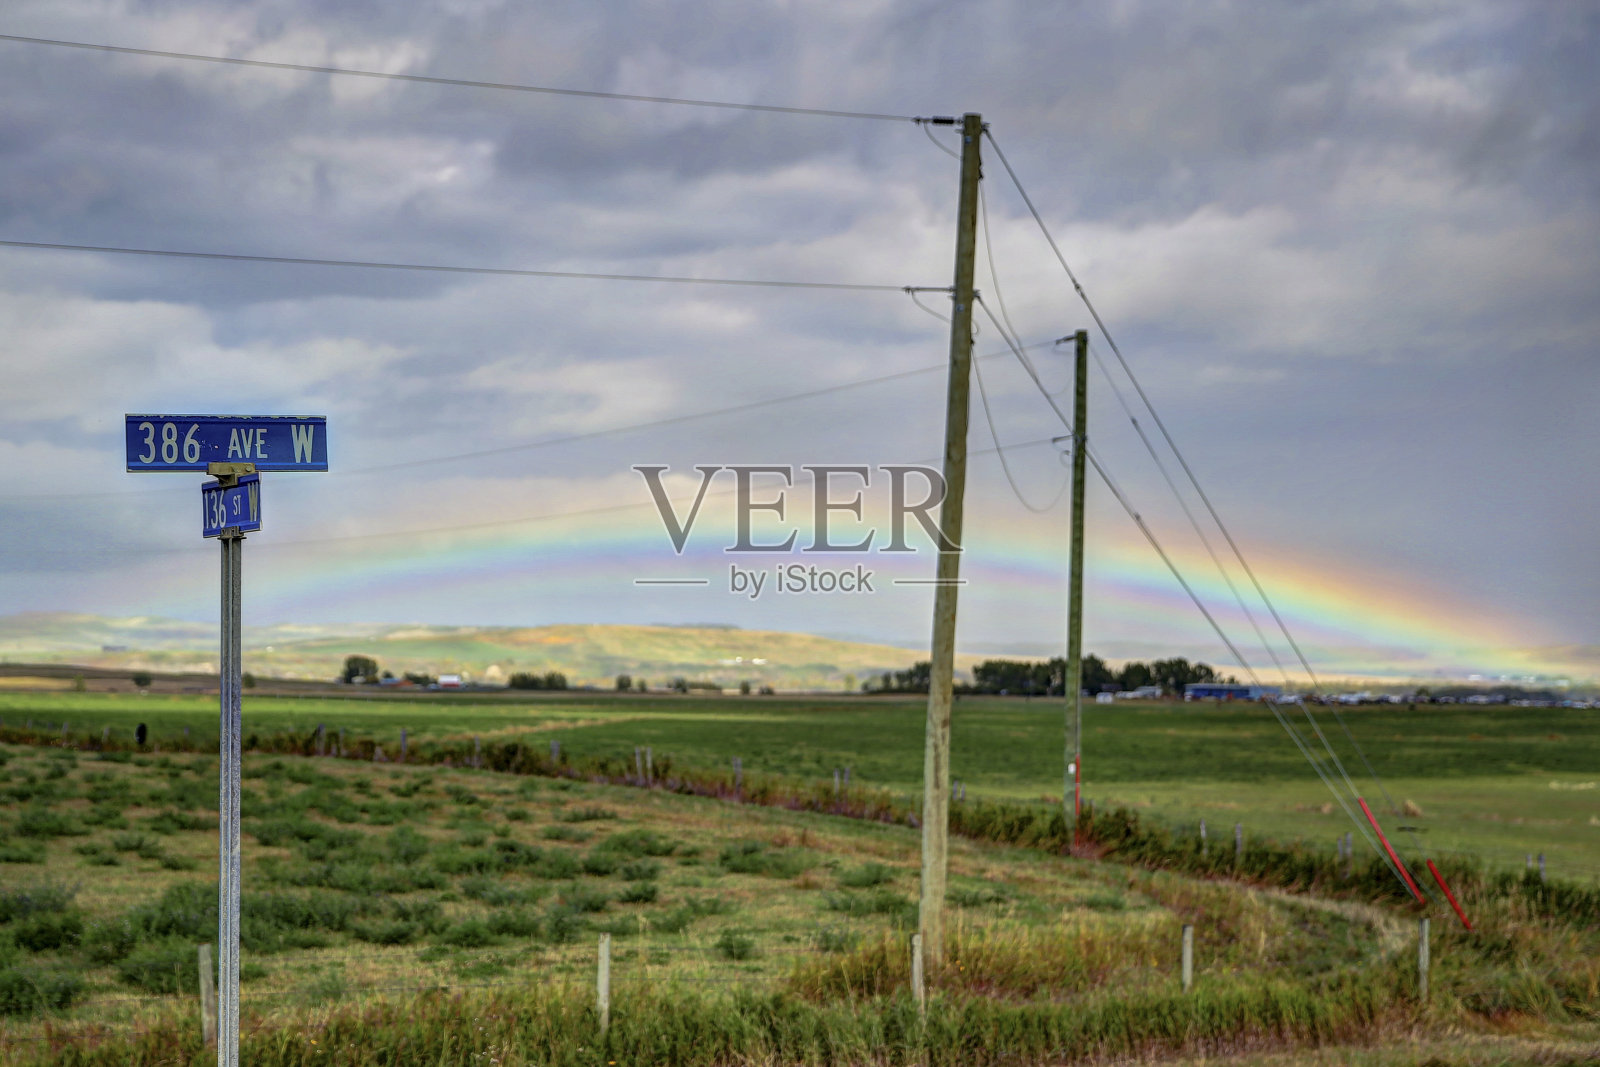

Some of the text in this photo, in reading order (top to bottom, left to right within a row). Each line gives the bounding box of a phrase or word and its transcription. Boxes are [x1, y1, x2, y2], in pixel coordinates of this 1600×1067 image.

[138, 422, 314, 463] 386 AVE W
[205, 482, 258, 528] 136 ST W
